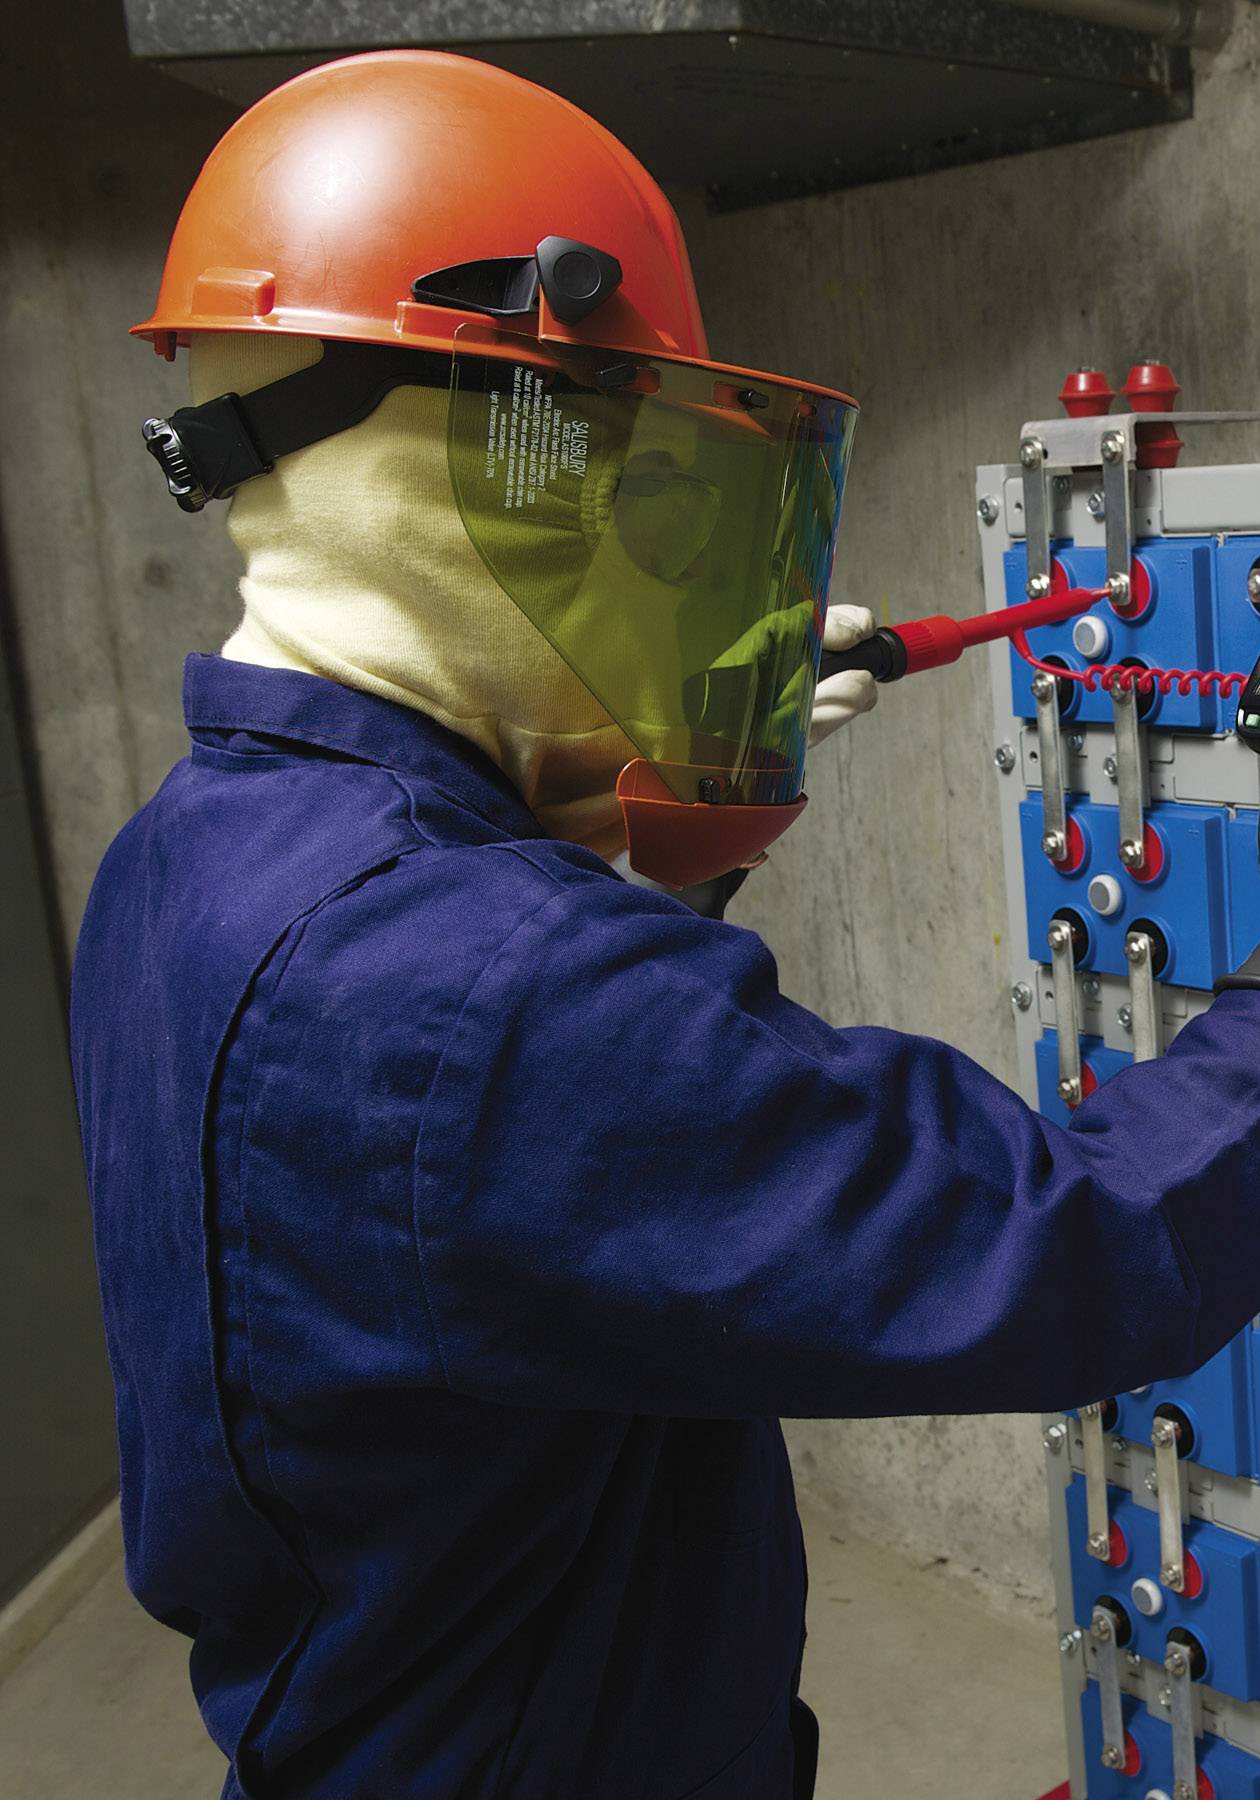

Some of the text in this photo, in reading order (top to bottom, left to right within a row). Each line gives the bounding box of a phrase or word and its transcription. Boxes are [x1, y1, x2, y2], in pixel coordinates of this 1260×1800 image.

[515, 366, 524, 382] Rated
[525, 370, 534, 386] Rated
[490, 391, 500, 404] Light
[544, 394, 552, 409] NFPA
[490, 404, 499, 437] Transmission
[532, 412, 541, 428] ASTM
[553, 408, 562, 427] Electric
[510, 426, 518, 440] used
[520, 434, 528, 446] used
[562, 422, 571, 442] MODEL
[488, 437, 496, 452] Value
[541, 434, 550, 452] Hazard
[552, 436, 560, 450] Flash
[569, 420, 590, 478] SALISBURY
[551, 451, 559, 464] Face
[537, 464, 548, 487] Category
[550, 464, 558, 480] Shield
